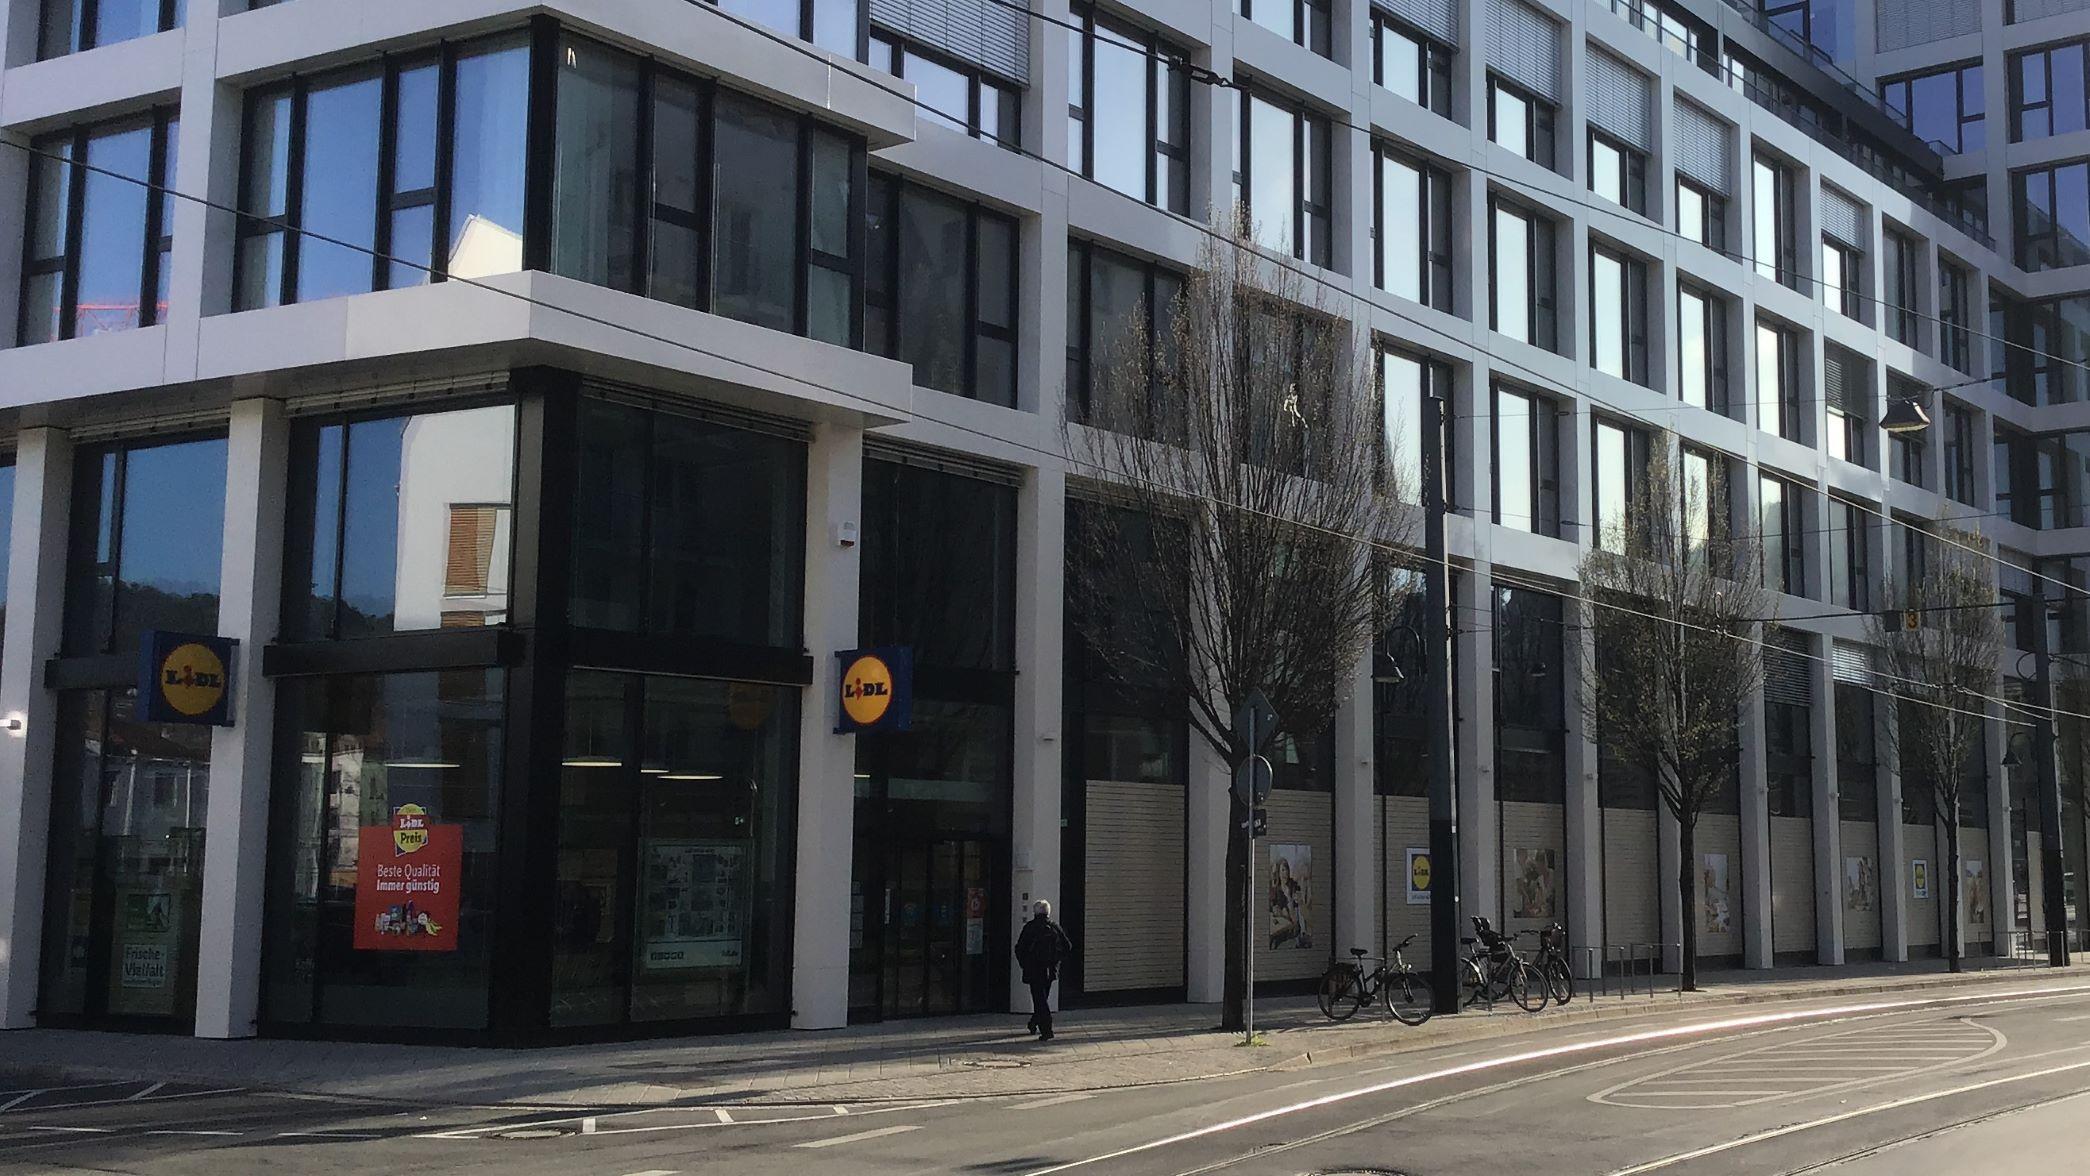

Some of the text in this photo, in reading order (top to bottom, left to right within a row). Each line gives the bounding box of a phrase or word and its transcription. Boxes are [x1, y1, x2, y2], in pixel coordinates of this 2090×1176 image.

[400, 831, 422, 844] Preis
[377, 863, 441, 881] Beste Qualität
[376, 878, 440, 894] Immer günstig
